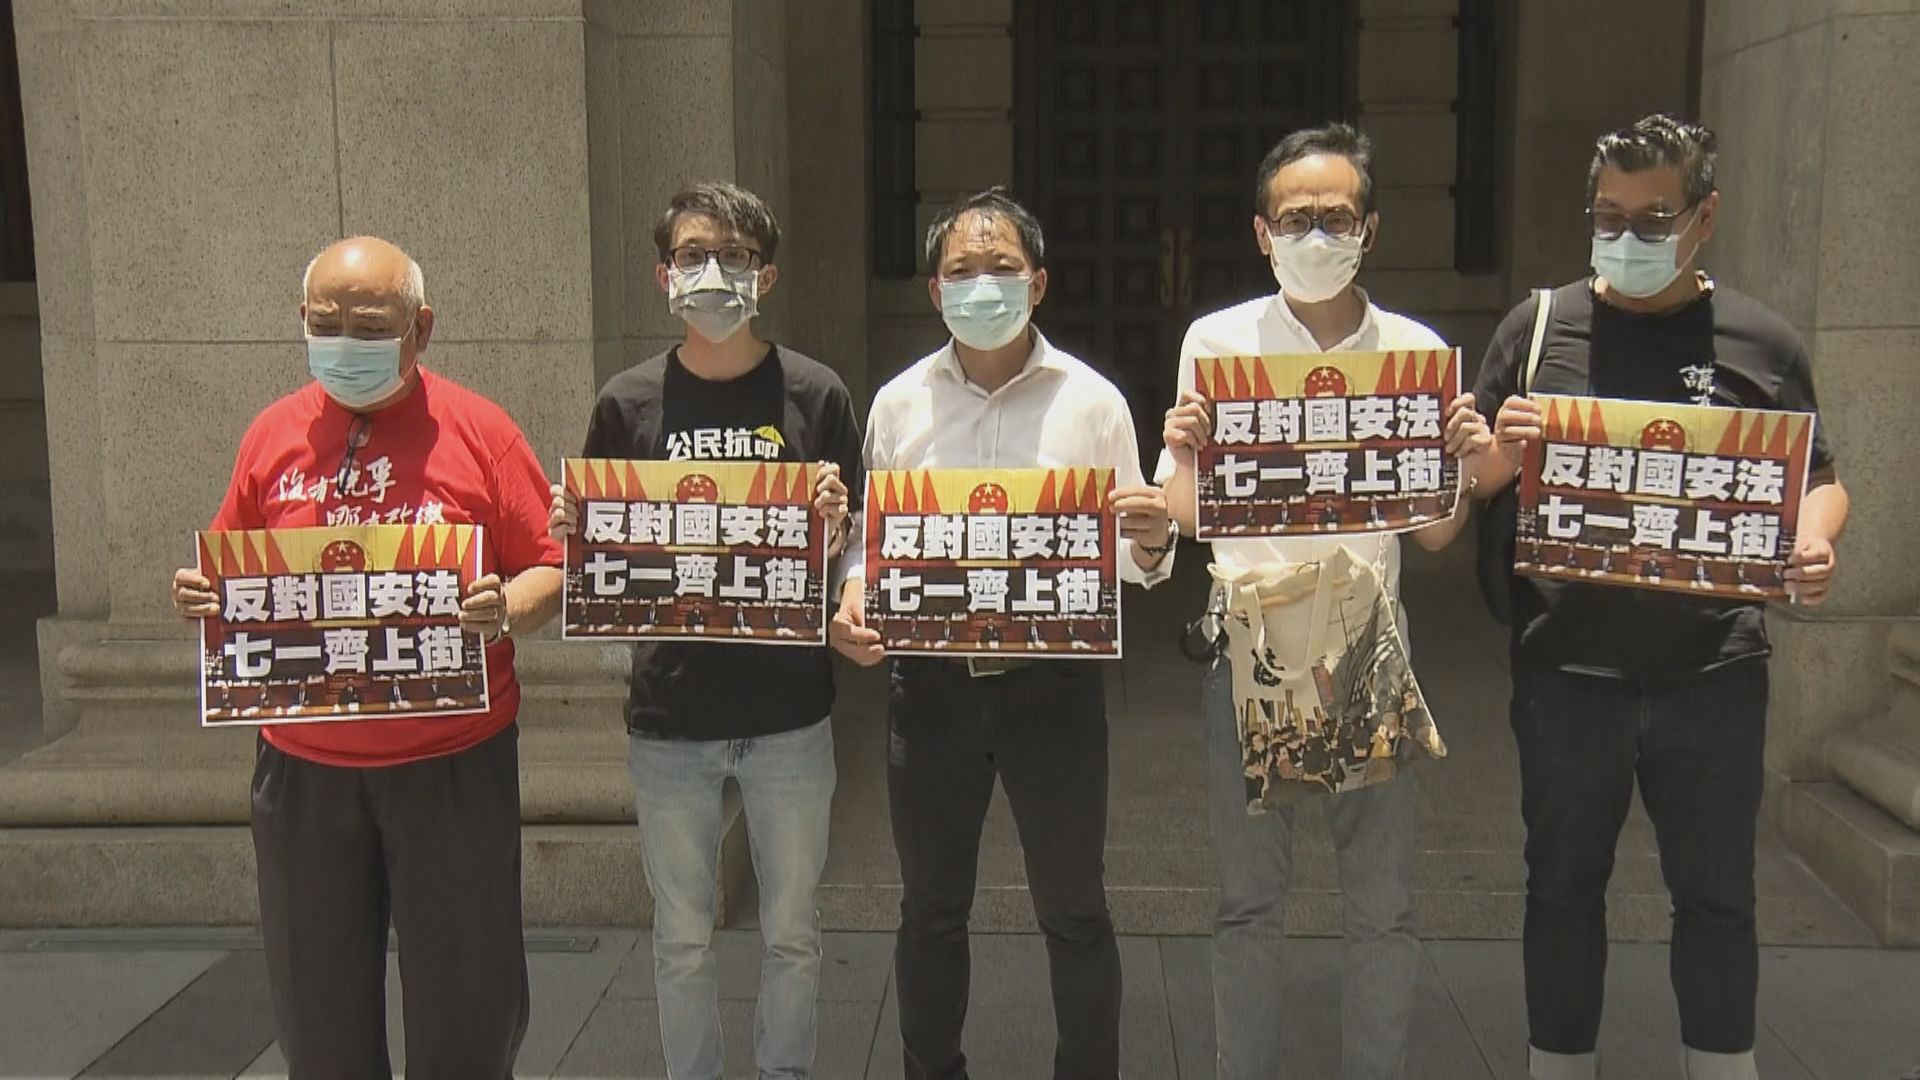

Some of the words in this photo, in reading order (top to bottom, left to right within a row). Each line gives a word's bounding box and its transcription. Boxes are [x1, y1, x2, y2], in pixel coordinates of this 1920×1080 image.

[1214, 394, 1441, 445] 反對國安法
[1214, 448, 1441, 497] 七一齊上街
[1540, 443, 1784, 505] 反對國安法
[584, 501, 809, 550] 反對國安法
[881, 514, 1101, 560] 反對國安法
[1538, 496, 1780, 558] 七一齊上街
[223, 570, 461, 623] 反對國安法
[584, 552, 808, 601] 七一齊上街
[880, 568, 1101, 613] 七一齊上街
[224, 625, 463, 678] 七一齊上街
